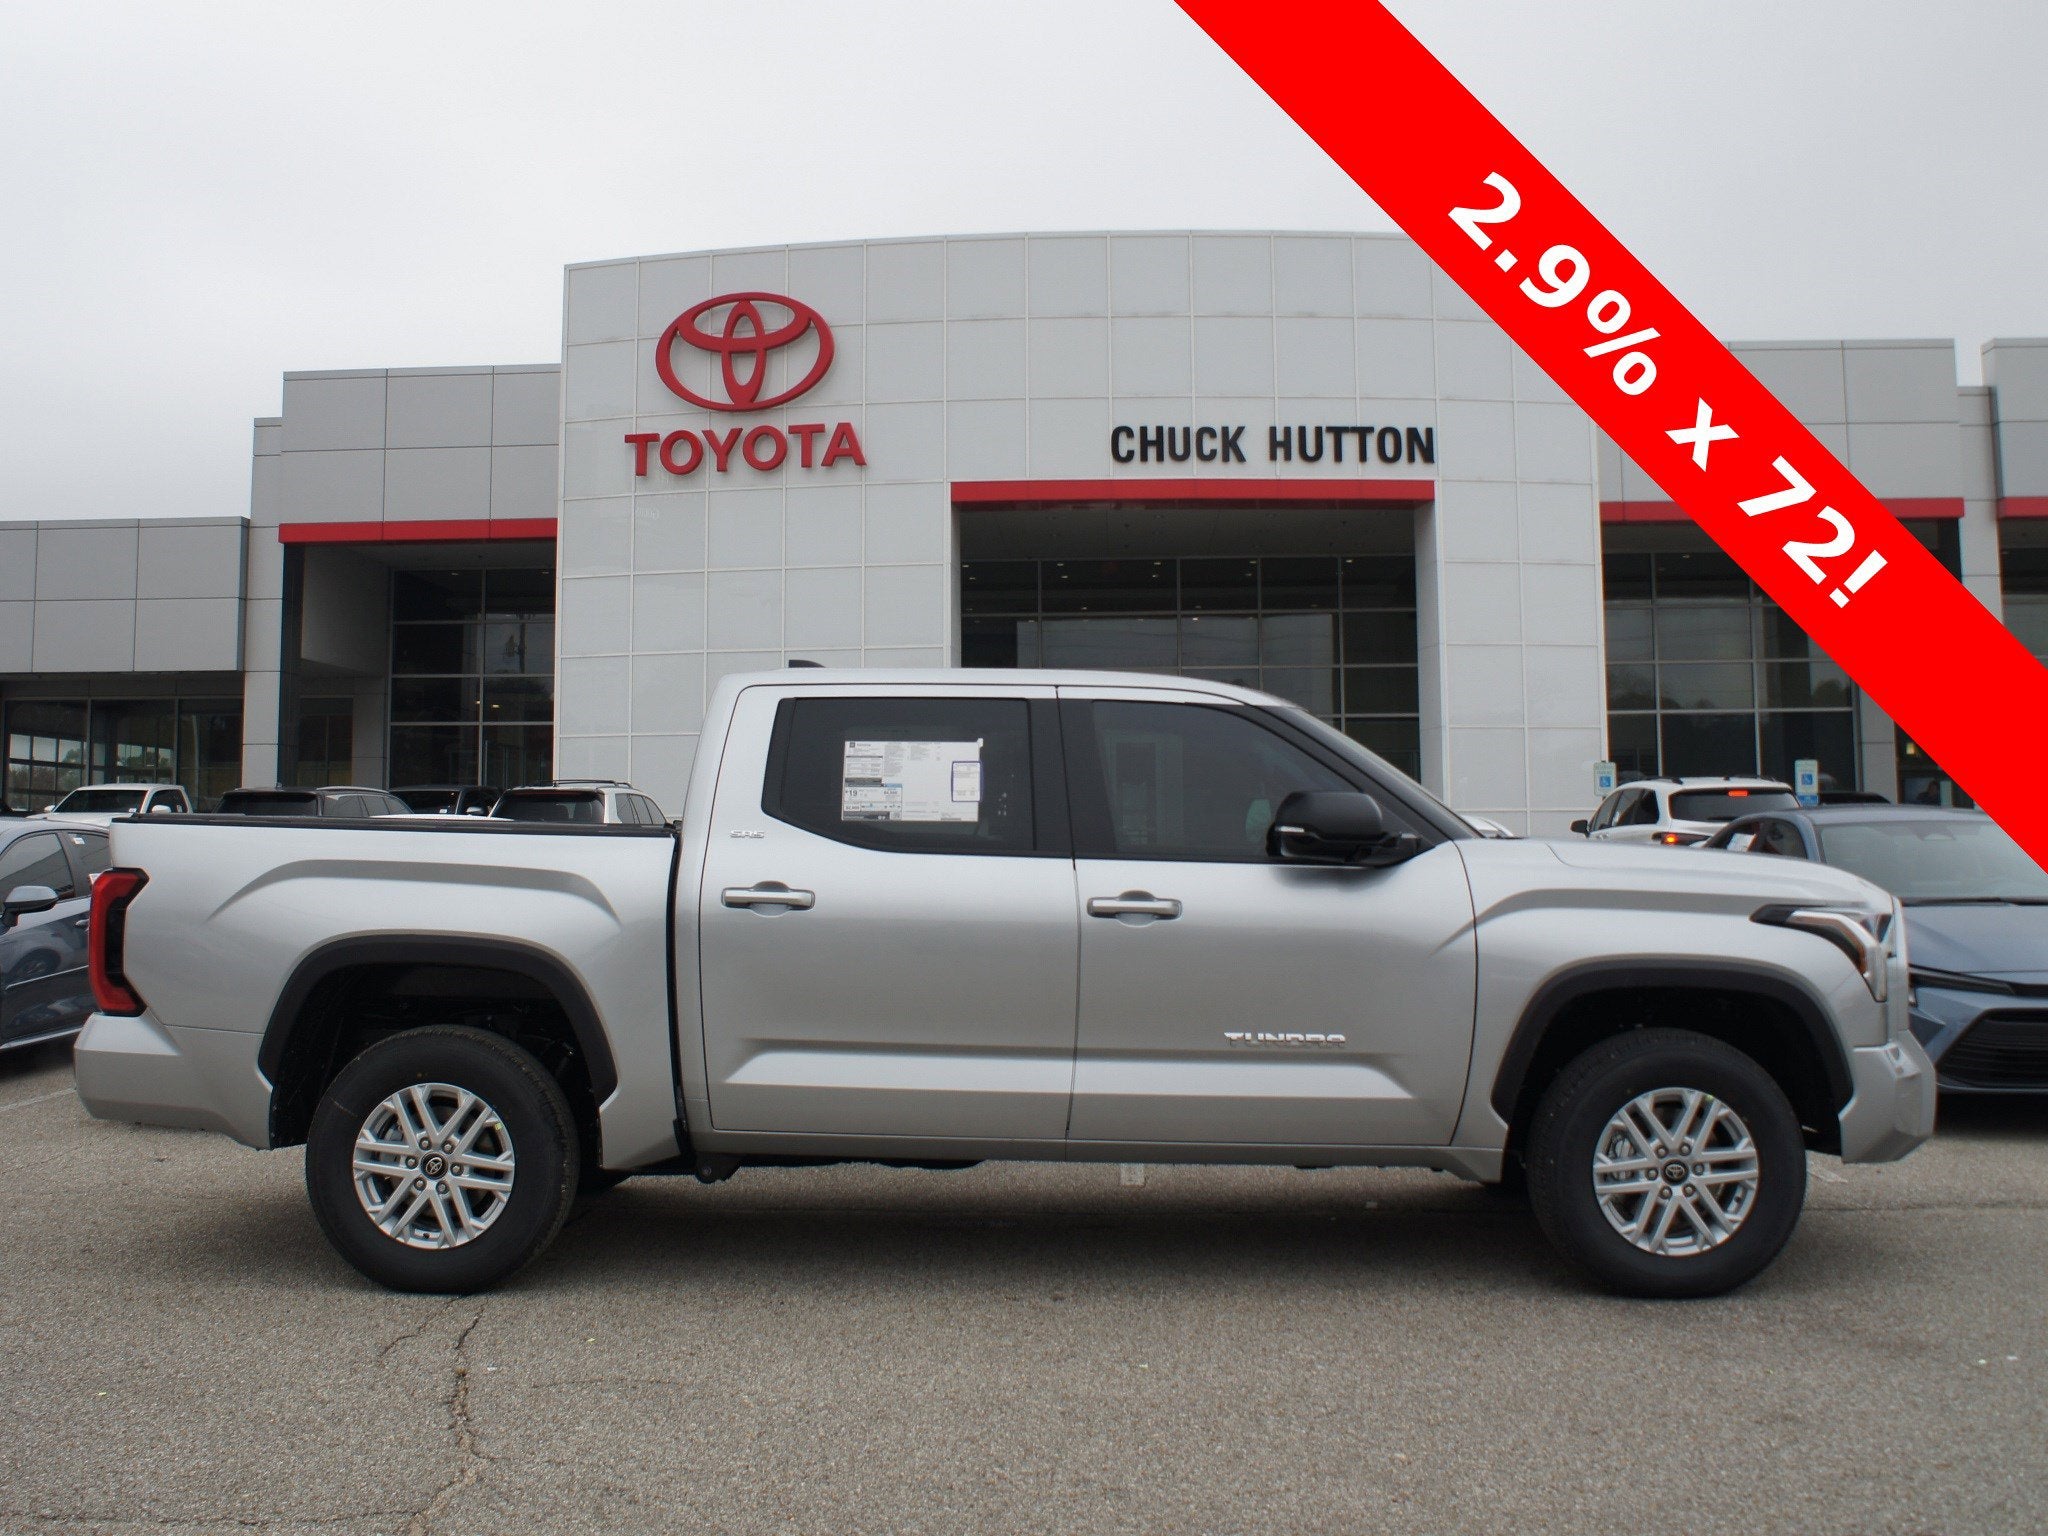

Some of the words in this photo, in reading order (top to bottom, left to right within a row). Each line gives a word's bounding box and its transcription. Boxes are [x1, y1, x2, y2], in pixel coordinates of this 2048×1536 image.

[624, 422, 867, 476] TOYOTA
[1110, 425, 1247, 463] CHUCK
[1268, 425, 1435, 464] HUTTON
[1223, 1031, 1346, 1047] TUNDRA
